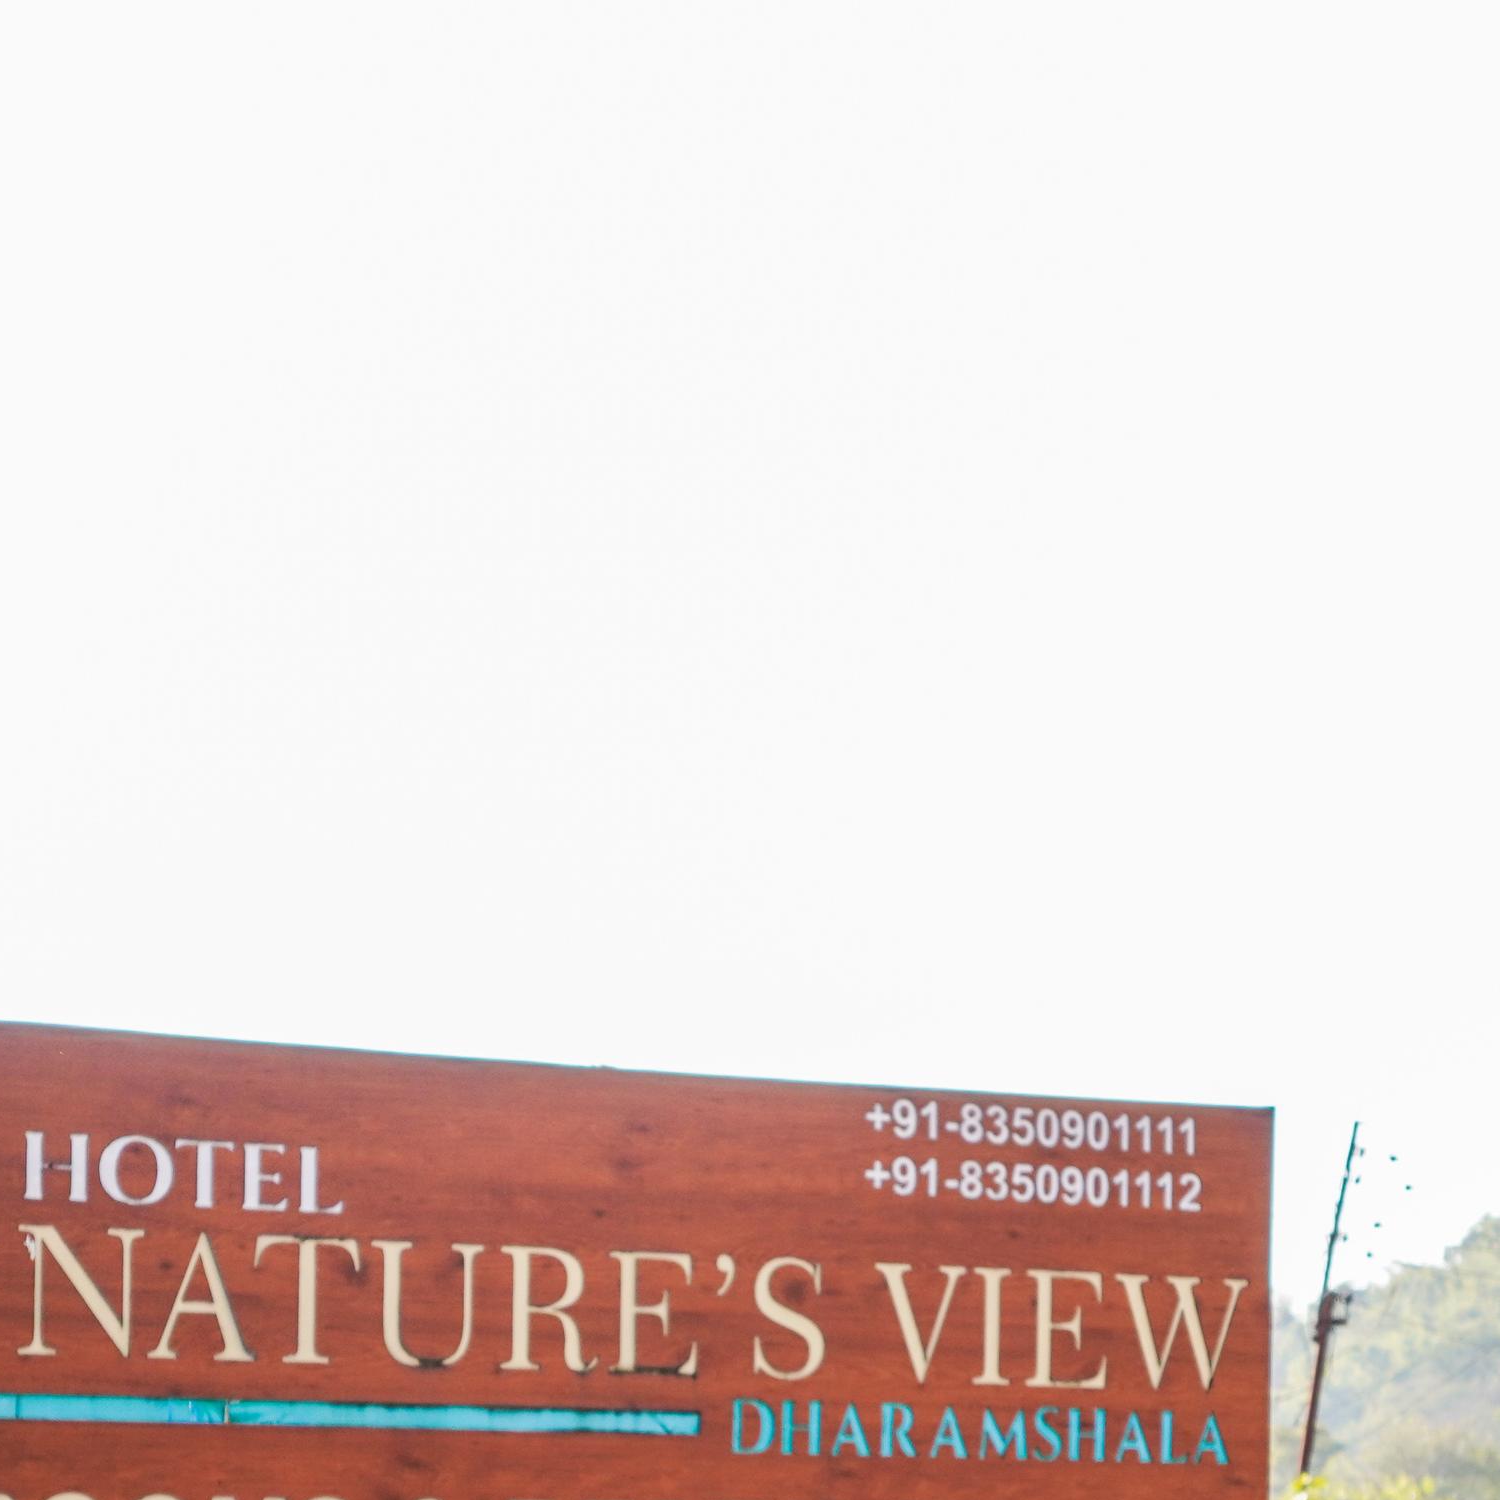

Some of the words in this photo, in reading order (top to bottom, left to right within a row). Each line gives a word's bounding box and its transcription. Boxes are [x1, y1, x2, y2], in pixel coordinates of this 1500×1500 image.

[864, 1098, 1197, 1156] +91-8350901111
[23, 1130, 344, 1215] HOTEL
[864, 1156, 1202, 1212] +91-8350901112
[17, 1223, 827, 1381] NATURE'S
[874, 1262, 1249, 1391] VIEW
[730, 1398, 1231, 1465] DHARAMSHALA
